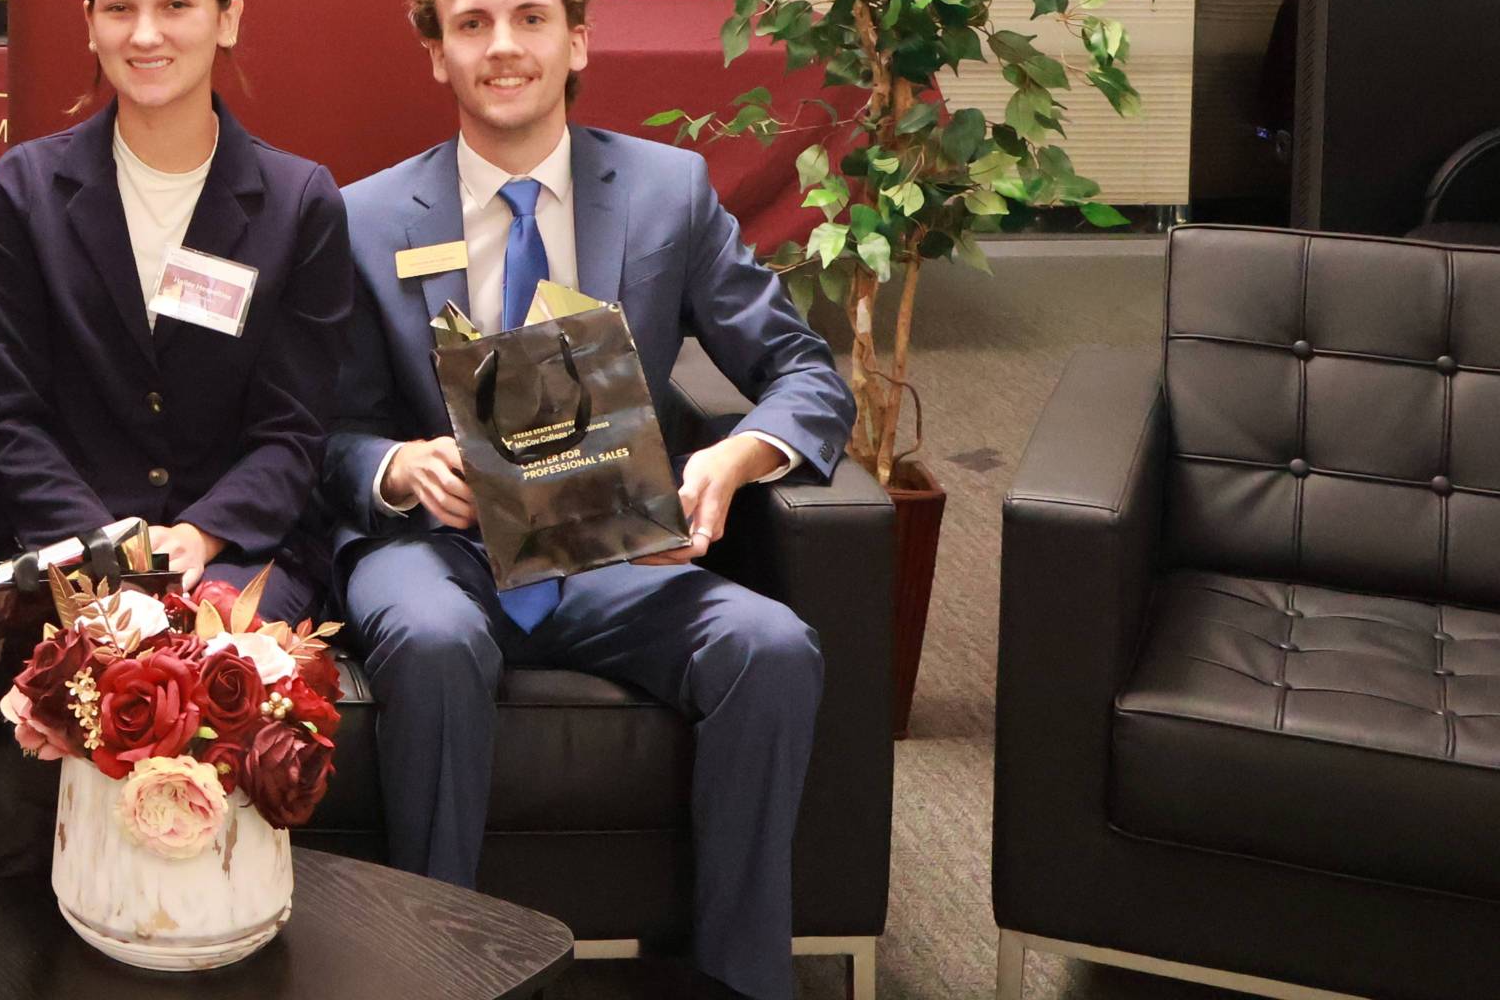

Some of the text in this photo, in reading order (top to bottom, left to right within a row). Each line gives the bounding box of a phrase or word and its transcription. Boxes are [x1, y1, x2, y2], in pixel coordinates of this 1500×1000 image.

[513, 431, 533, 440] TEXAS
[560, 449, 581, 461] FOR
[523, 447, 630, 480] PROFESSIONAL SALES
